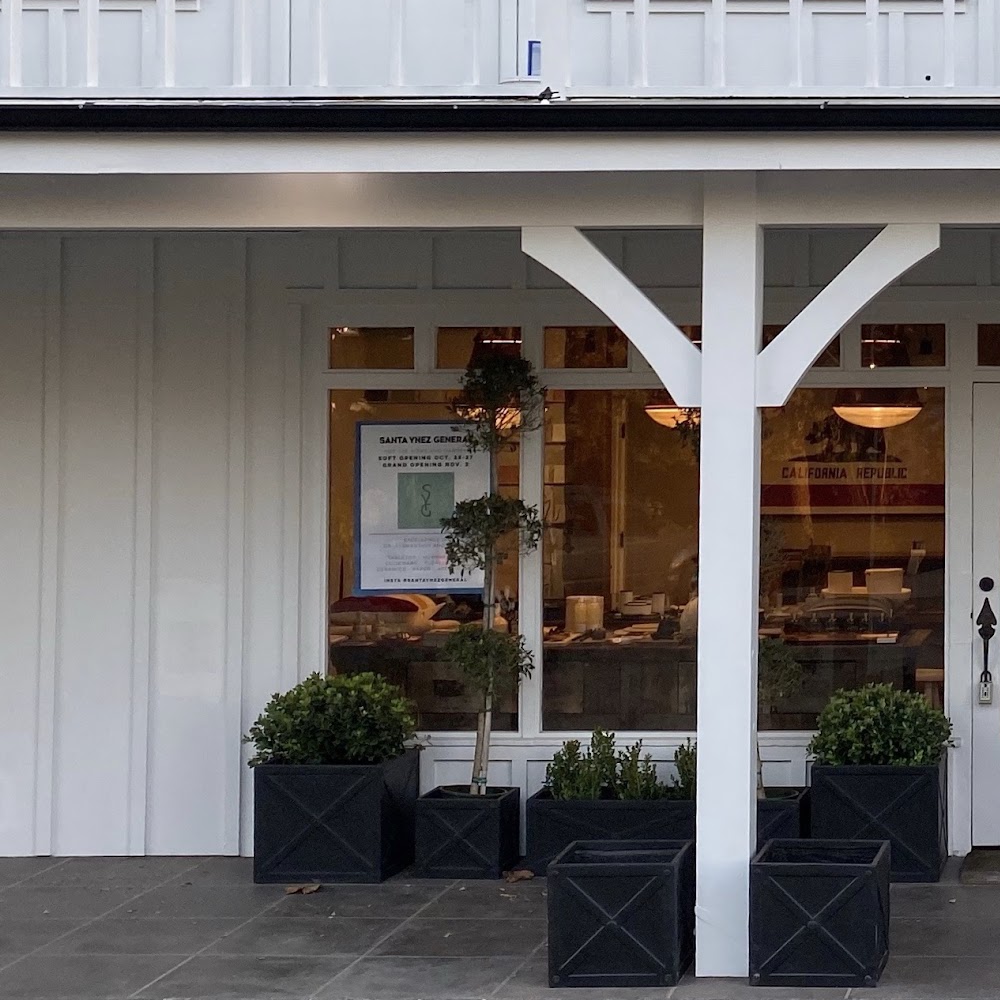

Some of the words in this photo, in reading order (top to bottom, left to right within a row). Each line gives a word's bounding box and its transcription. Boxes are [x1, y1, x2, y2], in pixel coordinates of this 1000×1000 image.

[379, 436, 408, 444] SANTA
[409, 436, 431, 444] YNEZ
[433, 435, 470, 443] GENERA
[782, 467, 848, 479] CALIFORNIA
[856, 467, 908, 479] REPUBLIC
